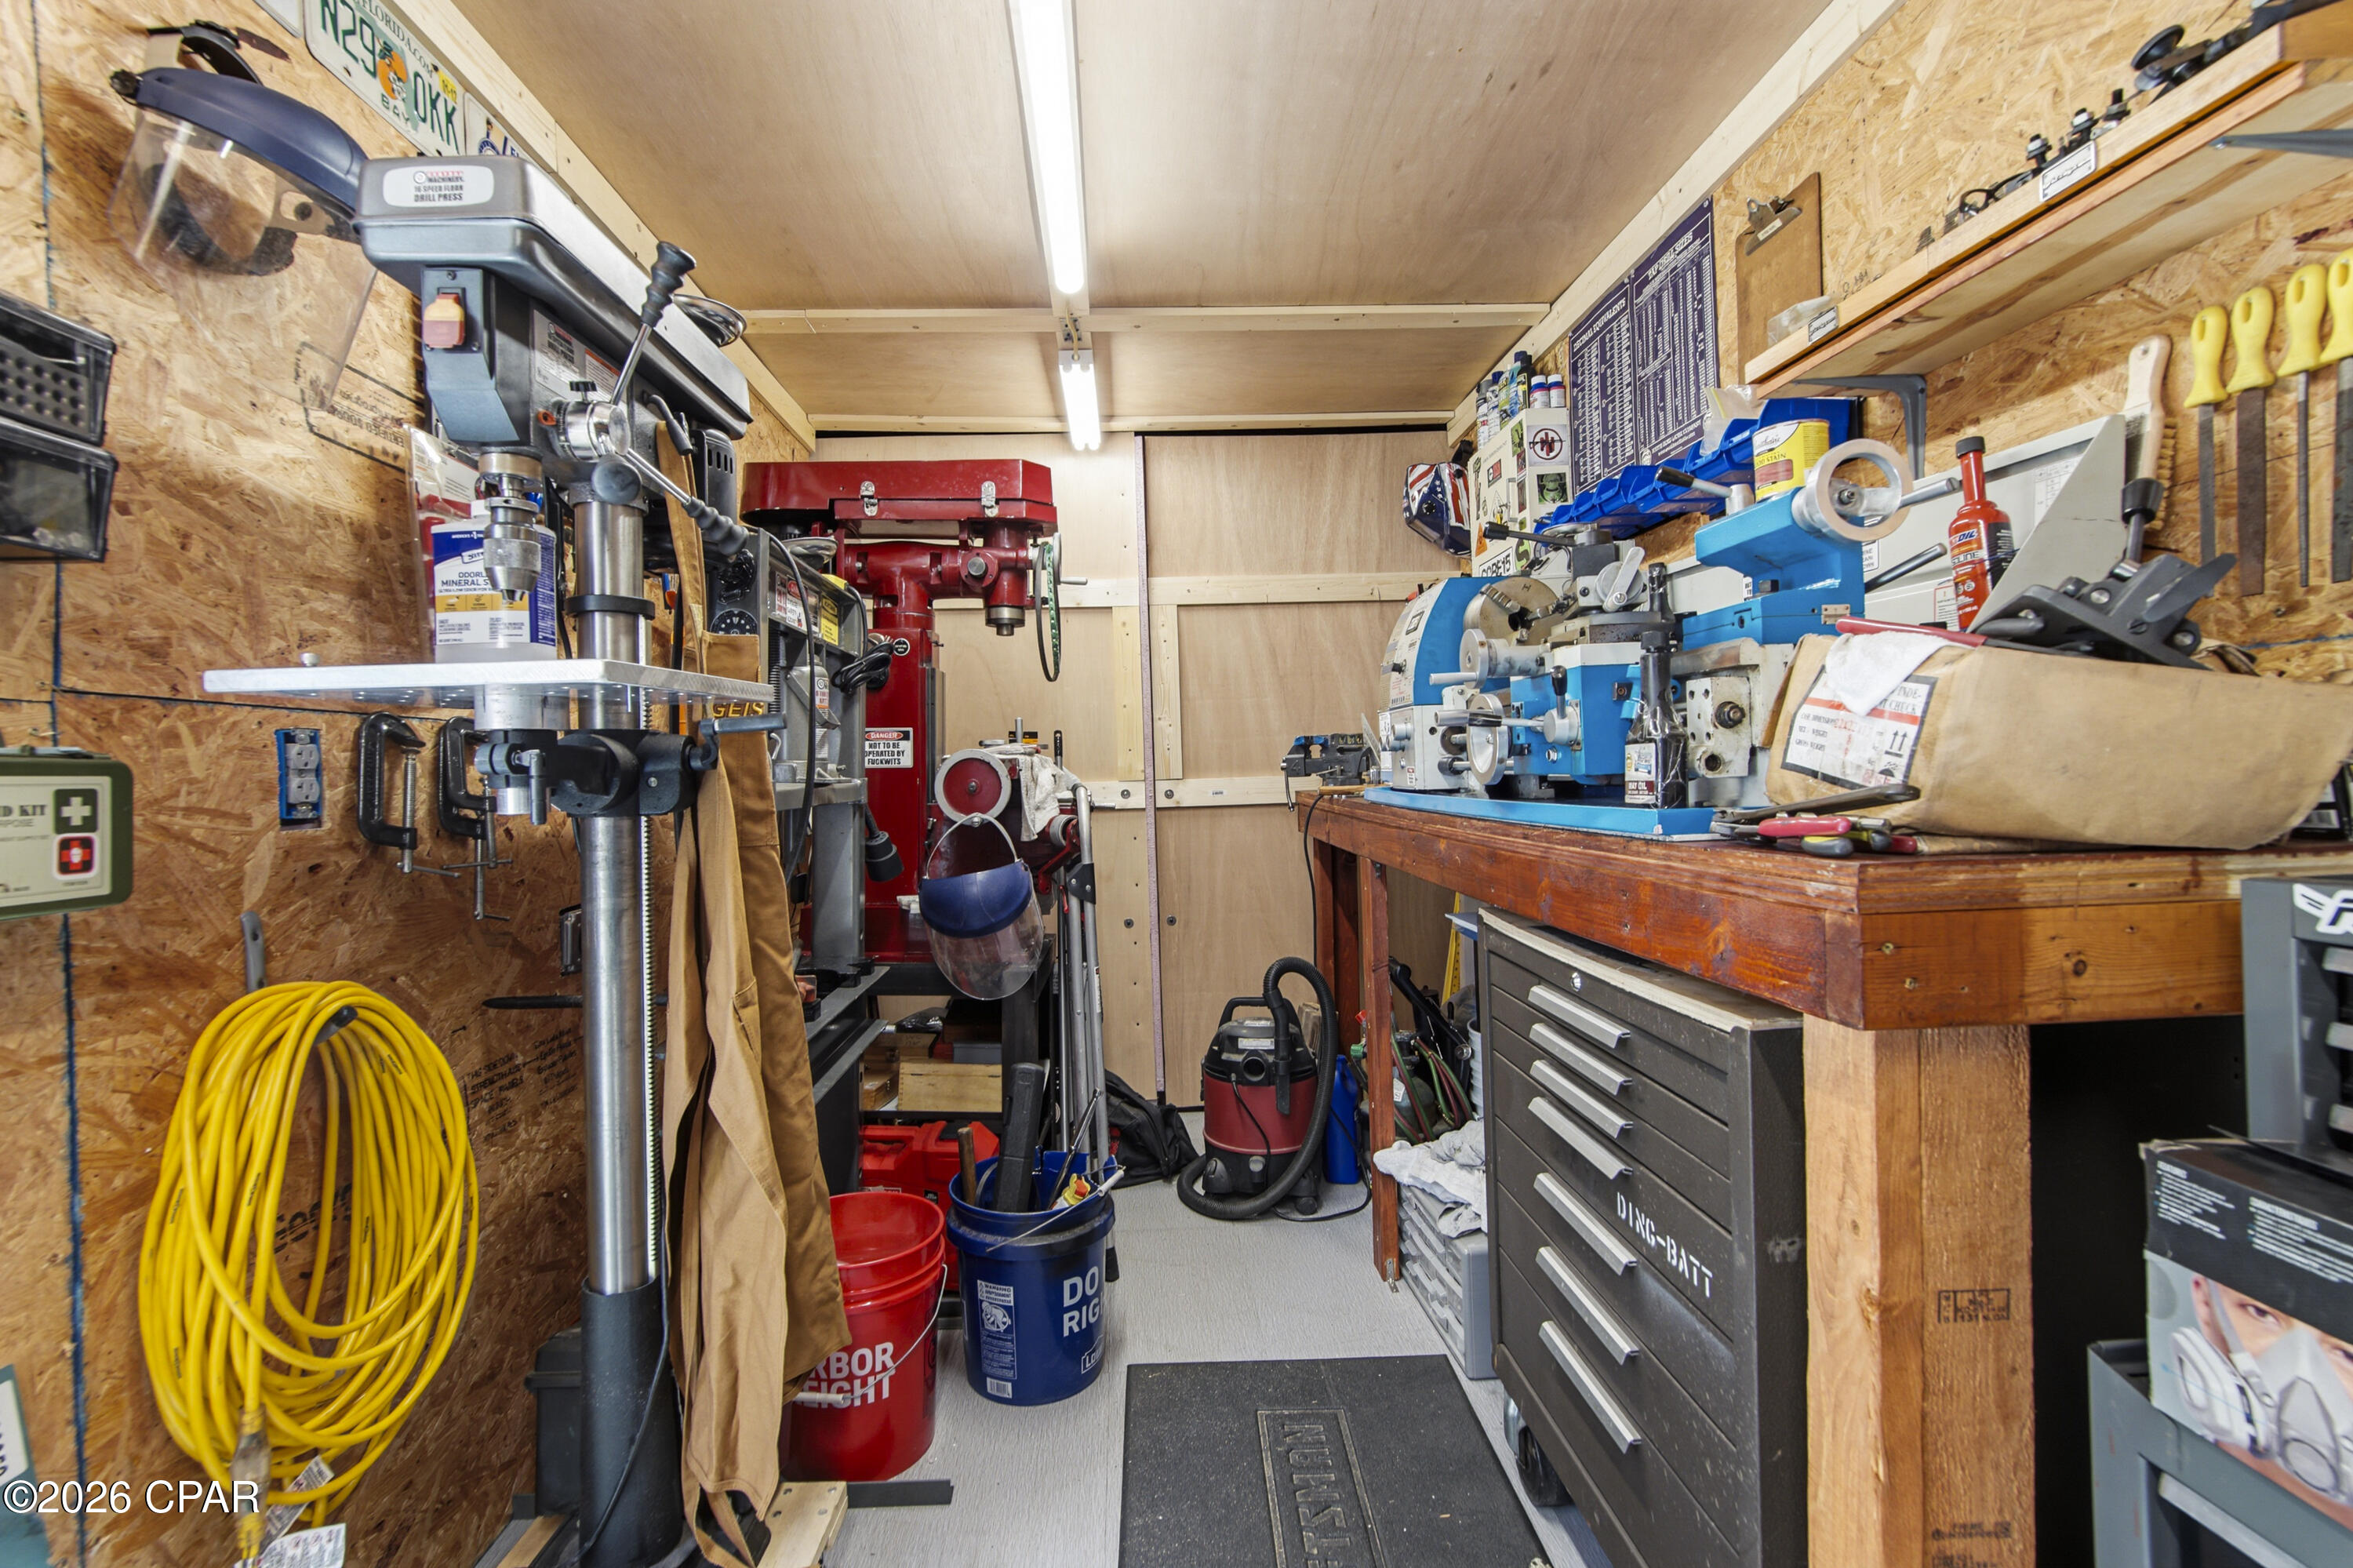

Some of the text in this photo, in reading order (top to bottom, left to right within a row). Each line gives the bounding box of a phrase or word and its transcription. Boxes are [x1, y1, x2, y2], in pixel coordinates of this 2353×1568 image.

[380, 93, 412, 127] BAY
[414, 194, 437, 202] DRILL
[442, 579, 482, 588] MINERAL
[1889, 700, 1917, 715] CHECK
[20, 805, 47, 816] KIT
[1617, 1191, 1713, 1298] DING-BATT
